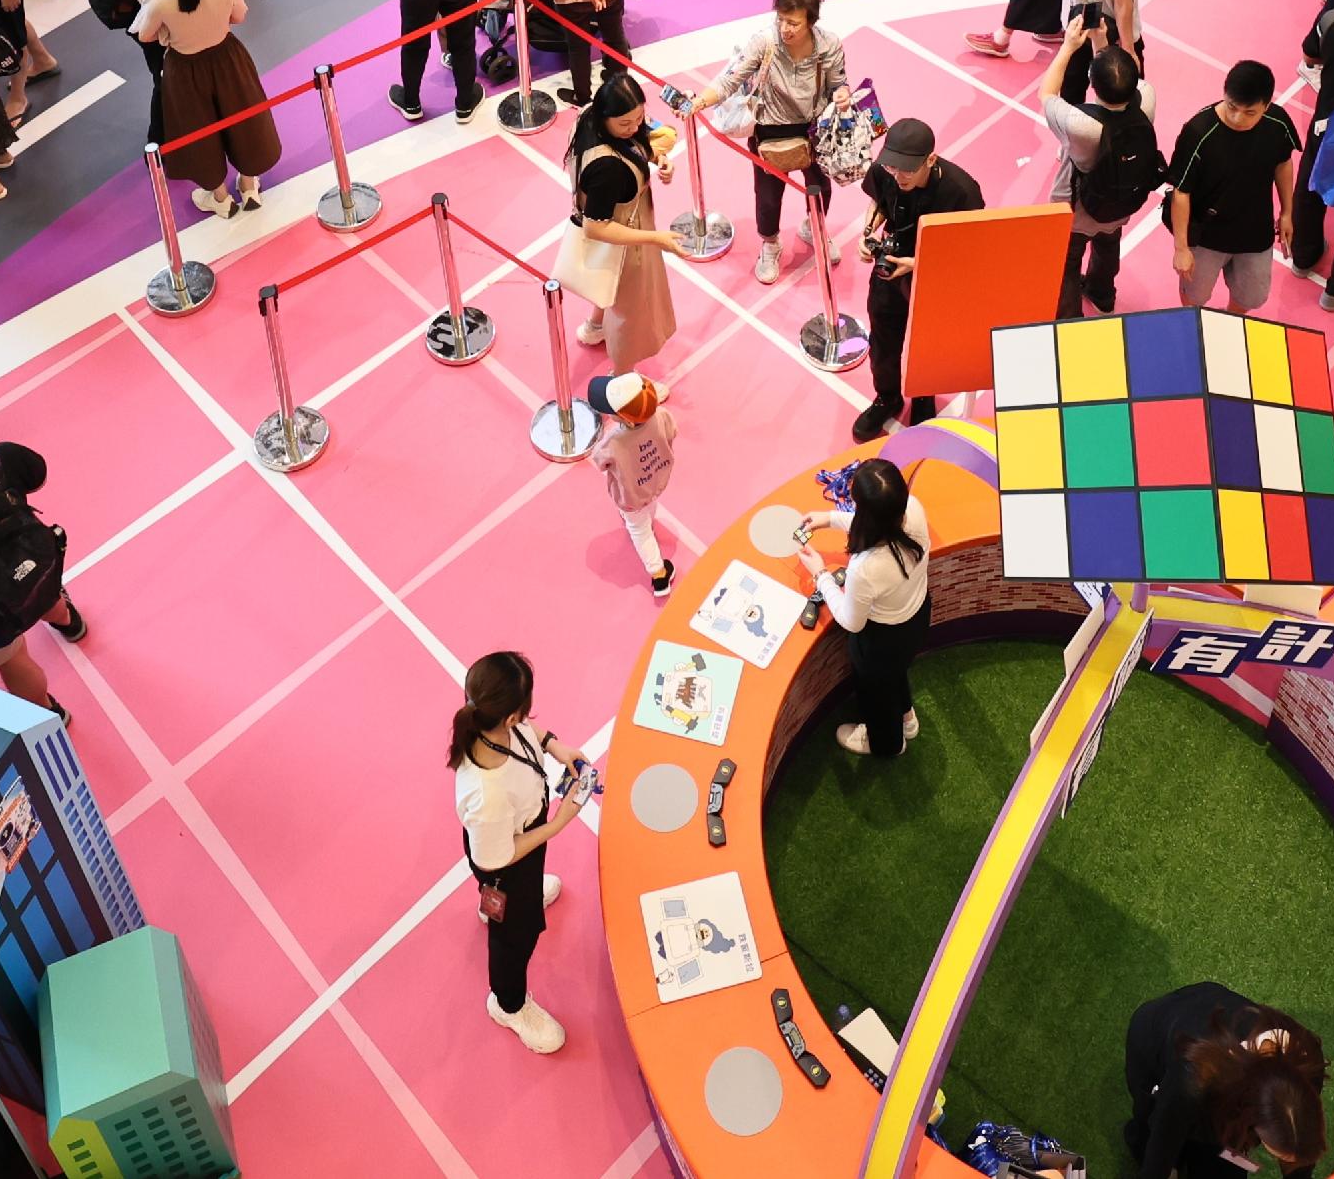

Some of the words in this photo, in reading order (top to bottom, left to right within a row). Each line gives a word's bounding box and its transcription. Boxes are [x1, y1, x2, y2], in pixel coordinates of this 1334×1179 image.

[638, 439, 653, 452] be
[639, 447, 657, 463] one
[1168, 625, 1334, 674] 有計
